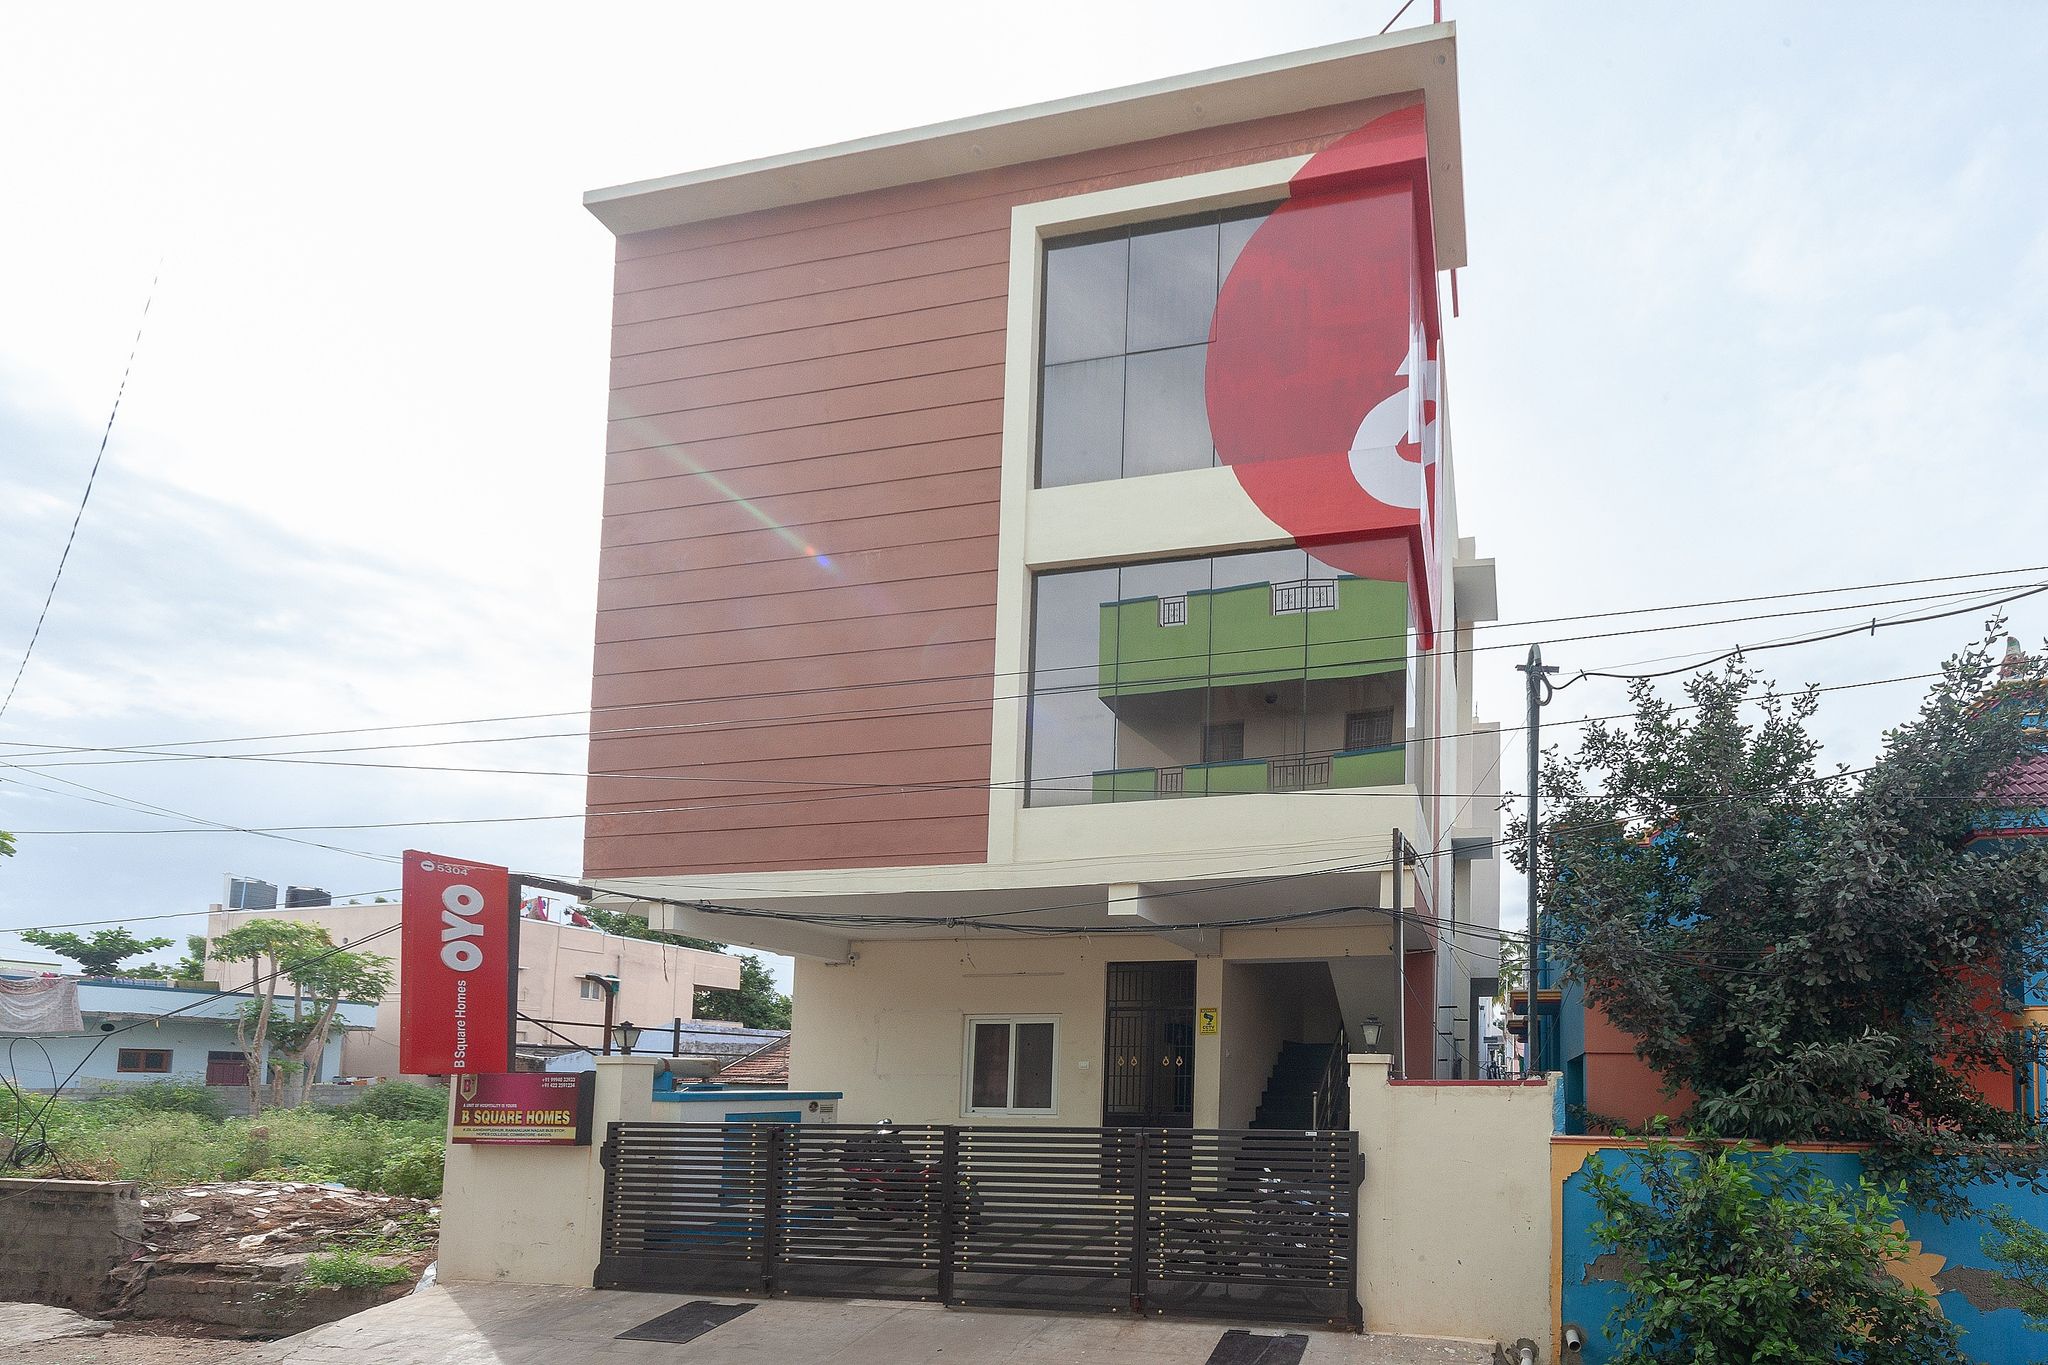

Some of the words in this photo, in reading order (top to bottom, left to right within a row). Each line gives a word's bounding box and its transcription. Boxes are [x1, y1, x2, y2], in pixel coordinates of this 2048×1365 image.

[437, 864, 468, 876] 5304
[441, 885, 484, 972] OYO
[455, 980, 466, 1017] Homes
[454, 1017, 468, 1058] Square
[454, 1059, 465, 1069] B
[461, 1110, 470, 1124] B
[474, 1110, 523, 1125] SQUARE
[526, 1110, 571, 1125] HOMES
